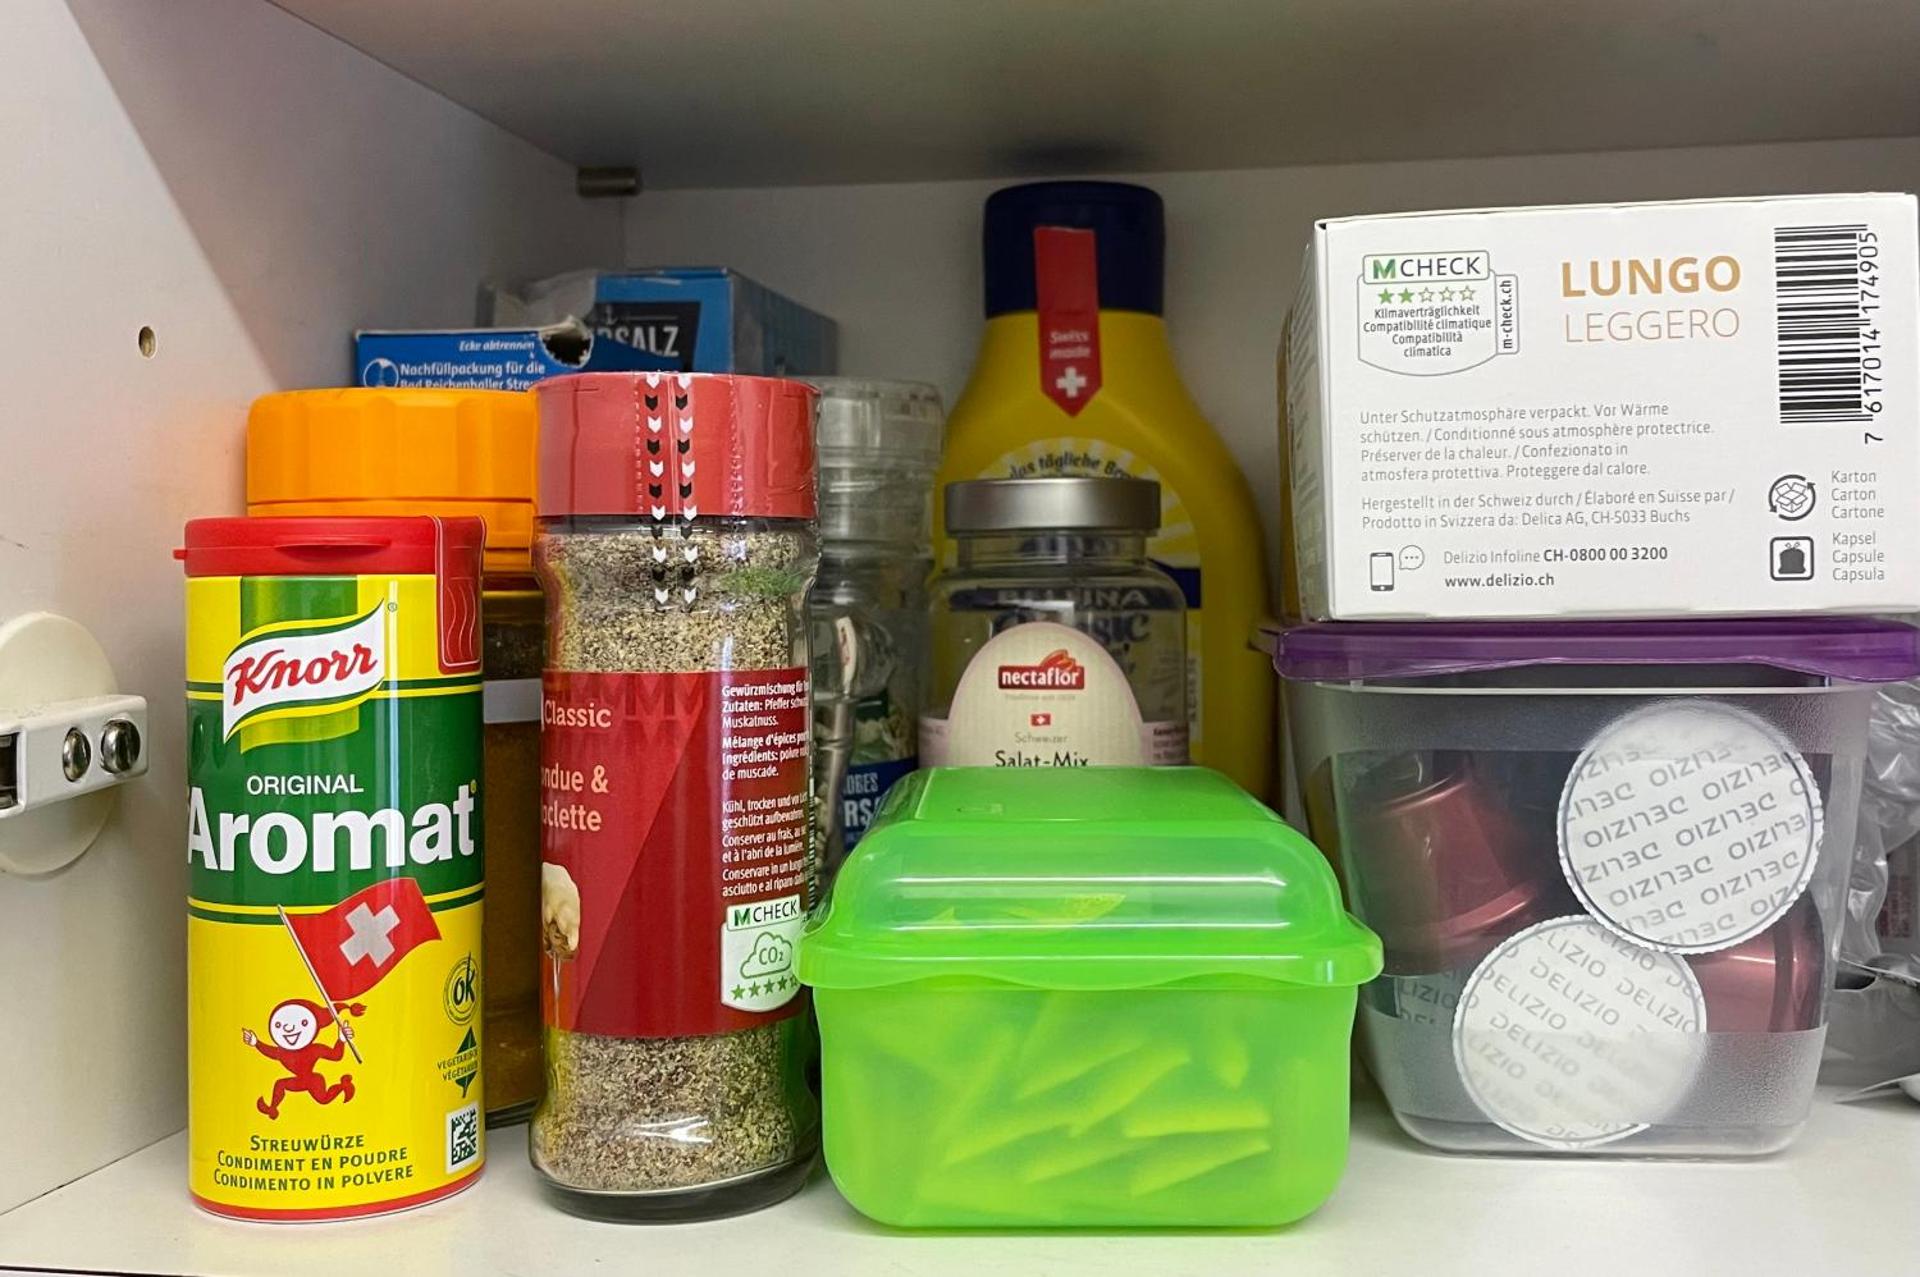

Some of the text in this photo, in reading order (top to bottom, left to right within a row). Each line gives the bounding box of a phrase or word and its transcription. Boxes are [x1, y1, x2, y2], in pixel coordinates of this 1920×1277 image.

[1562, 255, 1741, 298] LUNGO
[1375, 305, 1480, 318] Klimaverträglichkeit
[1499, 279, 1512, 349] m-check.ch
[1363, 317, 1491, 335] Compatibilité climatique
[1565, 307, 1740, 343] LEGGERO
[1392, 331, 1463, 346] Compatibilità
[1859, 232, 1883, 444] 7 617014 174905
[1404, 346, 1451, 358] climatica
[400, 361, 545, 379] Nachfüllpackung für die
[1360, 403, 1669, 424] Unter Schutzatmosphäre verpackt. Vor Wärme
[1435, 427, 1516, 441] Conditionné
[1520, 427, 1549, 439] sous
[1553, 423, 1632, 439] atmosphère
[1637, 421, 1715, 438] protectrice.
[1361, 449, 1421, 462] Préserver
[1425, 448, 1441, 460] de
[1444, 446, 1455, 459] la
[1459, 445, 1511, 460] chaleur.
[1522, 444, 1612, 458] Confezionato
[1616, 443, 1628, 456] in
[1361, 467, 1428, 481] atmosfera
[1507, 464, 1579, 481] Proteggere
[1583, 463, 1603, 476] dal
[1831, 470, 1876, 483] Karton
[1362, 496, 1434, 512] Hergestellt
[1438, 496, 1450, 508] in
[1453, 495, 1475, 508] der
[1480, 493, 1532, 508] Schweiz
[1535, 493, 1573, 506] durch
[1585, 490, 1635, 505] Élaboré
[1638, 493, 1655, 504] en
[1658, 489, 1701, 504] Suisse
[1704, 490, 1727, 505] par
[1831, 488, 1876, 501] Carton
[1362, 509, 1690, 529] Prodotto in Svizzera da: Delica AG, CH-5033 Buchs
[1831, 506, 1884, 519] Cartone
[1832, 532, 1876, 548] Kapsel
[1444, 547, 1667, 564] Delizio Infoline CH-0800 00 3200
[1832, 550, 1885, 566] Capsule
[1445, 572, 1554, 587] www.delizio.ch
[1832, 568, 1885, 583] Capsula
[227, 642, 377, 706] Knorr
[1001, 667, 1079, 686] nectaflor
[545, 700, 611, 728] Classic
[722, 700, 763, 713] Zutaten:
[722, 715, 779, 729] Muskatnuss.
[722, 735, 763, 750] Mélange
[722, 749, 778, 767] Ingrédients:
[995, 749, 1089, 768] Salat-Mix
[591, 764, 609, 793] &
[722, 765, 779, 781] de muscade.
[246, 774, 364, 796] ORIGINAL
[723, 799, 745, 813] Kühl,
[747, 796, 776, 811] trocken
[777, 794, 791, 807] und
[187, 783, 474, 875] Aromat
[722, 813, 764, 832] geschützt
[1584, 795, 1689, 848] DELIZIO
[1674, 792, 1777, 847] DELIZIO
[722, 832, 765, 848] Conserver
[766, 831, 777, 843] au
[722, 850, 733, 863] et
[733, 848, 740, 862] à
[764, 845, 774, 858] de
[775, 844, 783, 857] la
[722, 864, 770, 881] Conservare
[770, 861, 779, 875] in
[780, 862, 788, 874] un
[1700, 851, 1800, 906] DELIZIO
[722, 879, 758, 897] asciutto
[758, 883, 765, 893] e
[765, 879, 773, 892] al
[1609, 855, 1714, 908] DELIZIO
[1529, 957, 1620, 1026] DELIZIO
[250, 1134, 364, 1152] STREUWÜRZE
[218, 1147, 408, 1172] CONDIMENT EN POUDRE
[214, 1164, 414, 1191] CONDIMENTO IN POLVERE
